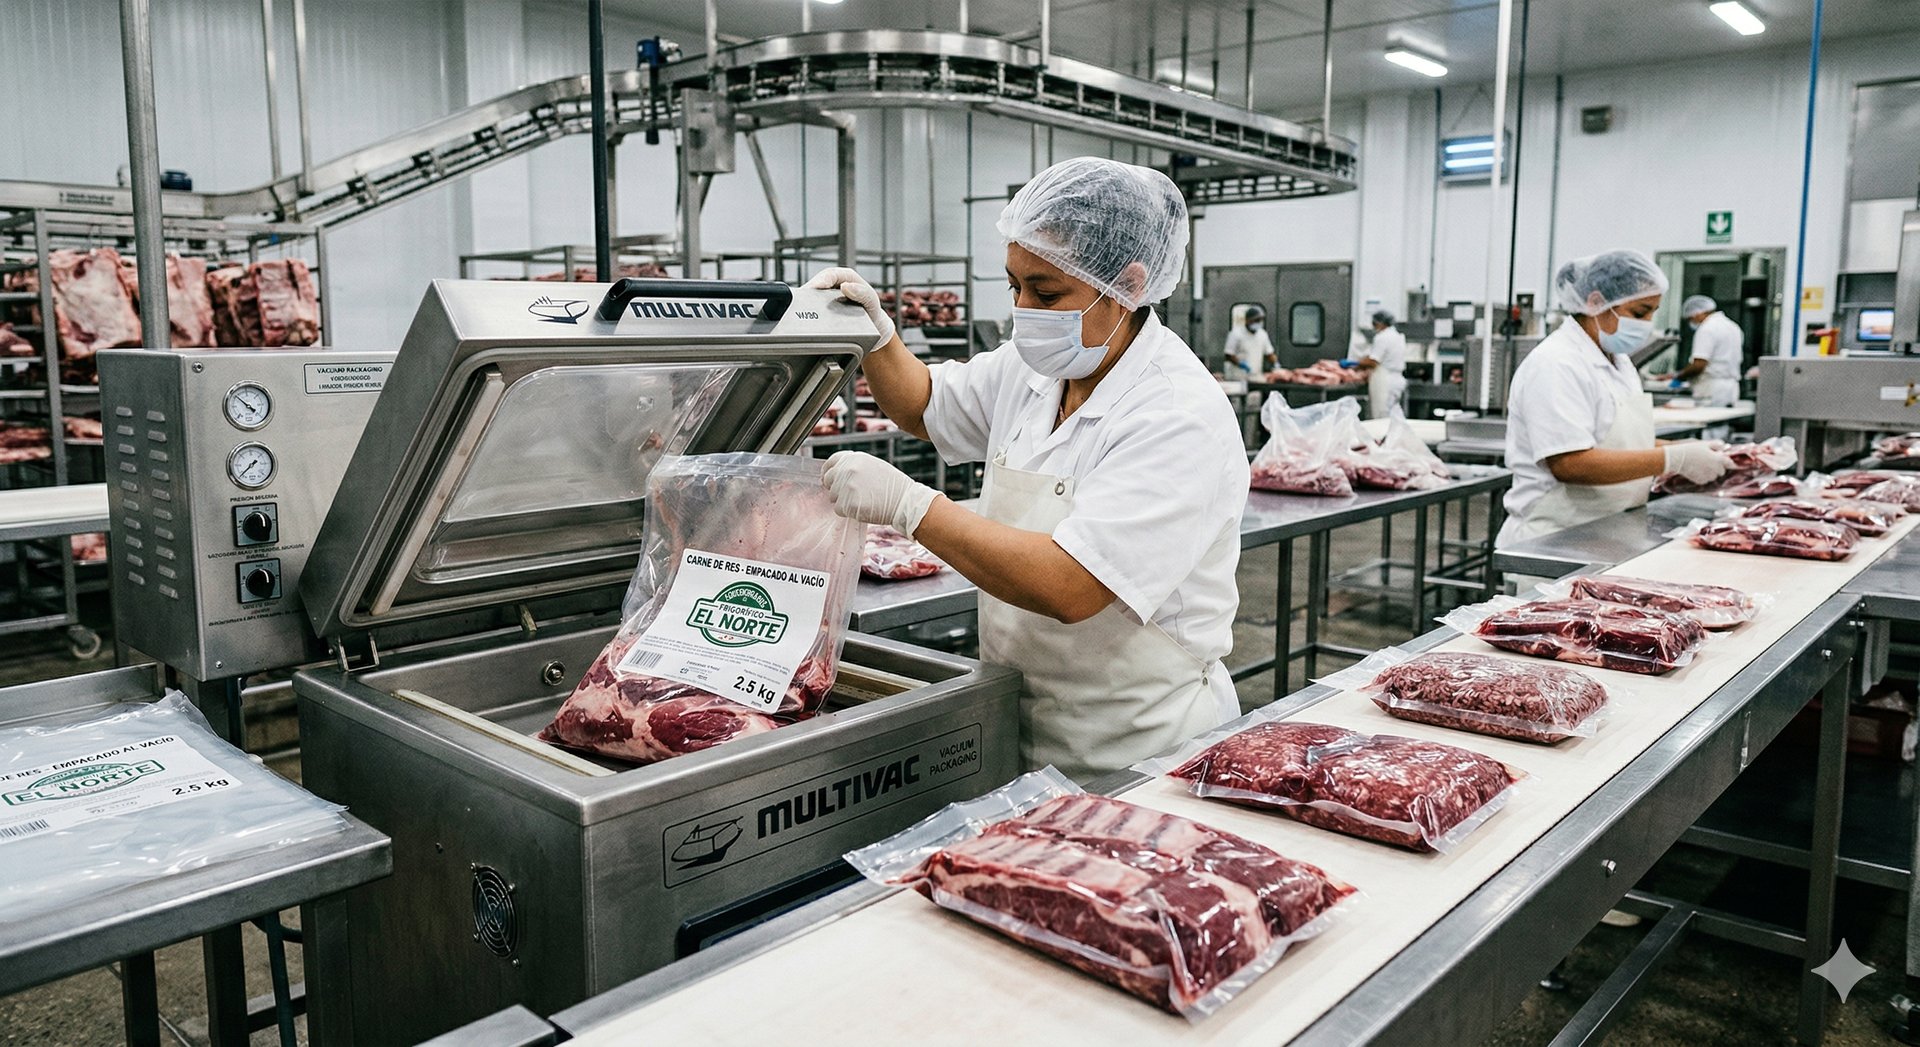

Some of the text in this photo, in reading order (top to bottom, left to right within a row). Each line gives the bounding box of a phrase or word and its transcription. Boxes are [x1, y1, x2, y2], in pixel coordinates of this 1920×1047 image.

[630, 302, 759, 318] MULTIVAC
[686, 554, 713, 568] CARNE
[713, 560, 724, 570] DE
[725, 562, 741, 573] RES
[745, 565, 787, 582] EMPACADO
[788, 573, 799, 584] AL
[801, 574, 825, 588] VACÍO
[693, 608, 781, 640] EL NORTE
[733, 675, 757, 694] 2.5
[757, 684, 776, 704] kg
[52, 749, 120, 770] EMPACADO
[123, 745, 139, 753] AL
[939, 737, 974, 758] VACUUM
[929, 750, 977, 776] PACKAGING
[16, 790, 55, 802] EL
[58, 763, 156, 792] NORTE
[171, 779, 229, 796] 2.5 kg
[757, 754, 920, 839] MULTIVAC
